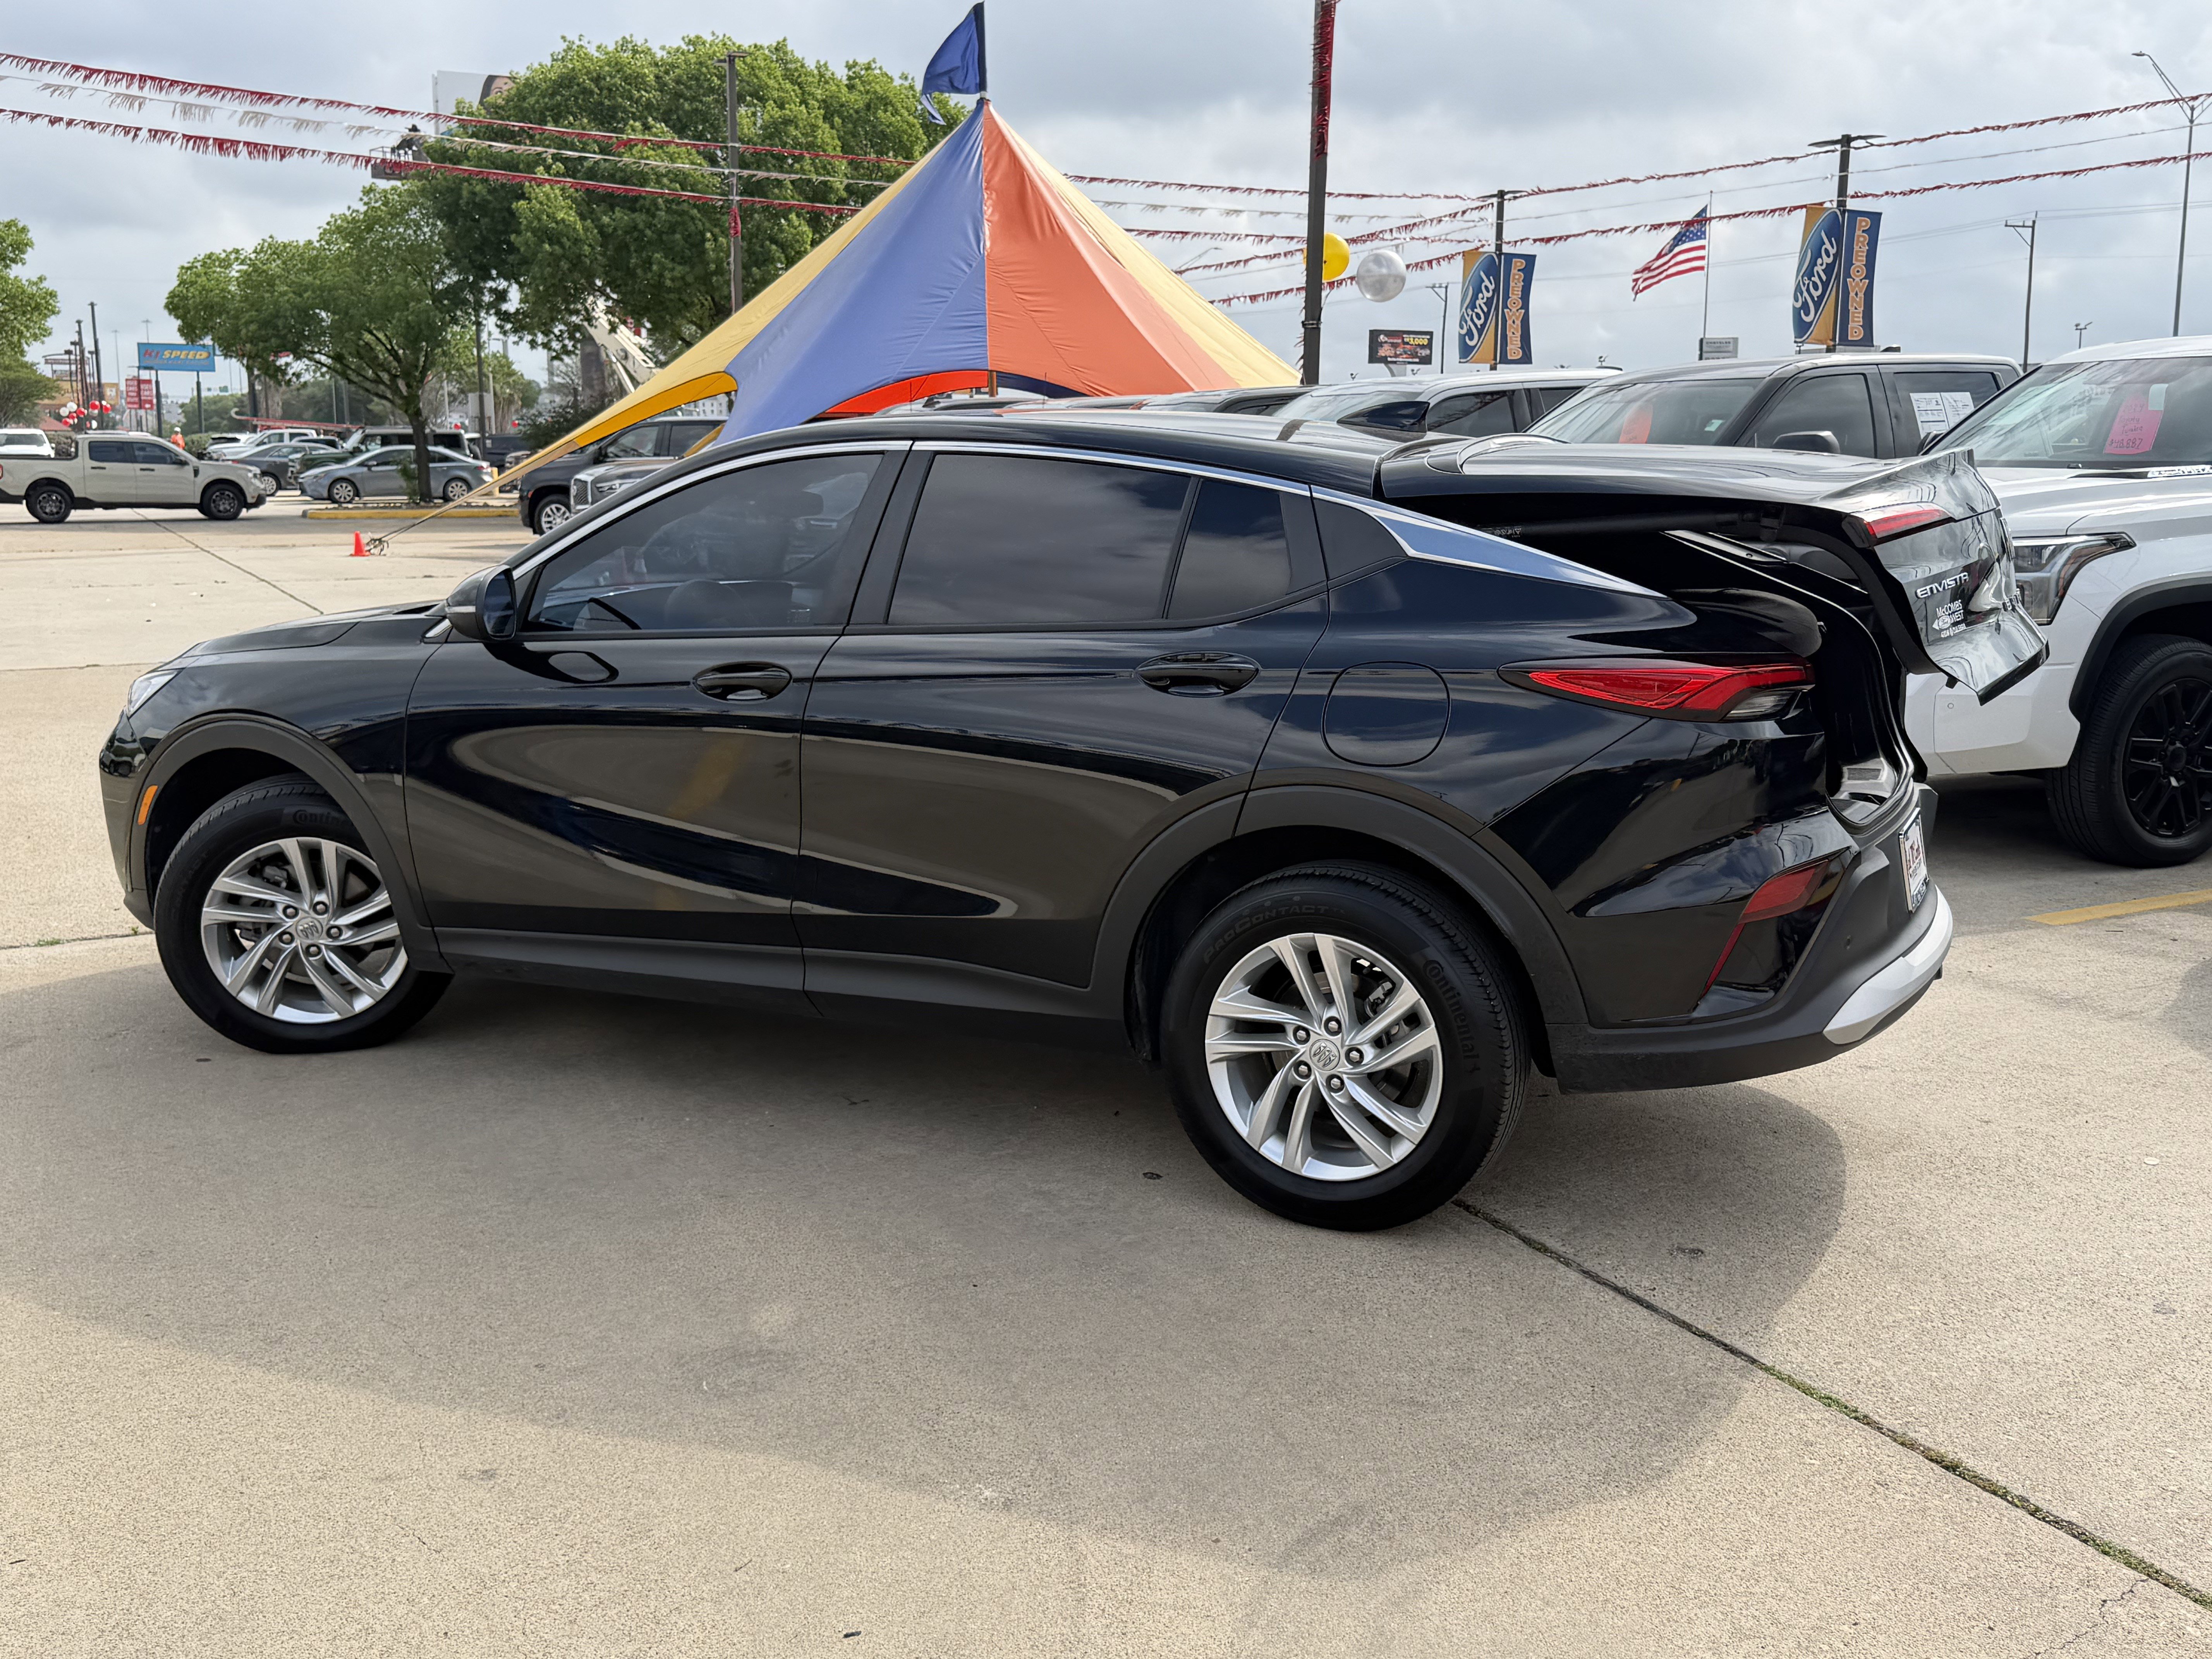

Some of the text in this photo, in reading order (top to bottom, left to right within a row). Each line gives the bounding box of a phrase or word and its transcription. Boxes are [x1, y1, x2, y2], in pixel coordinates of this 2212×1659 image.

[1459, 271, 1495, 347] Ford
[1504, 259, 1526, 360] PREOWNED
[1793, 230, 1836, 322] Ford
[1847, 217, 1870, 340] PREOWNED
[163, 350, 210, 359] SPEED
[1916, 572, 1969, 598] ENVISTA
[1422, 960, 1480, 1060] Continental
